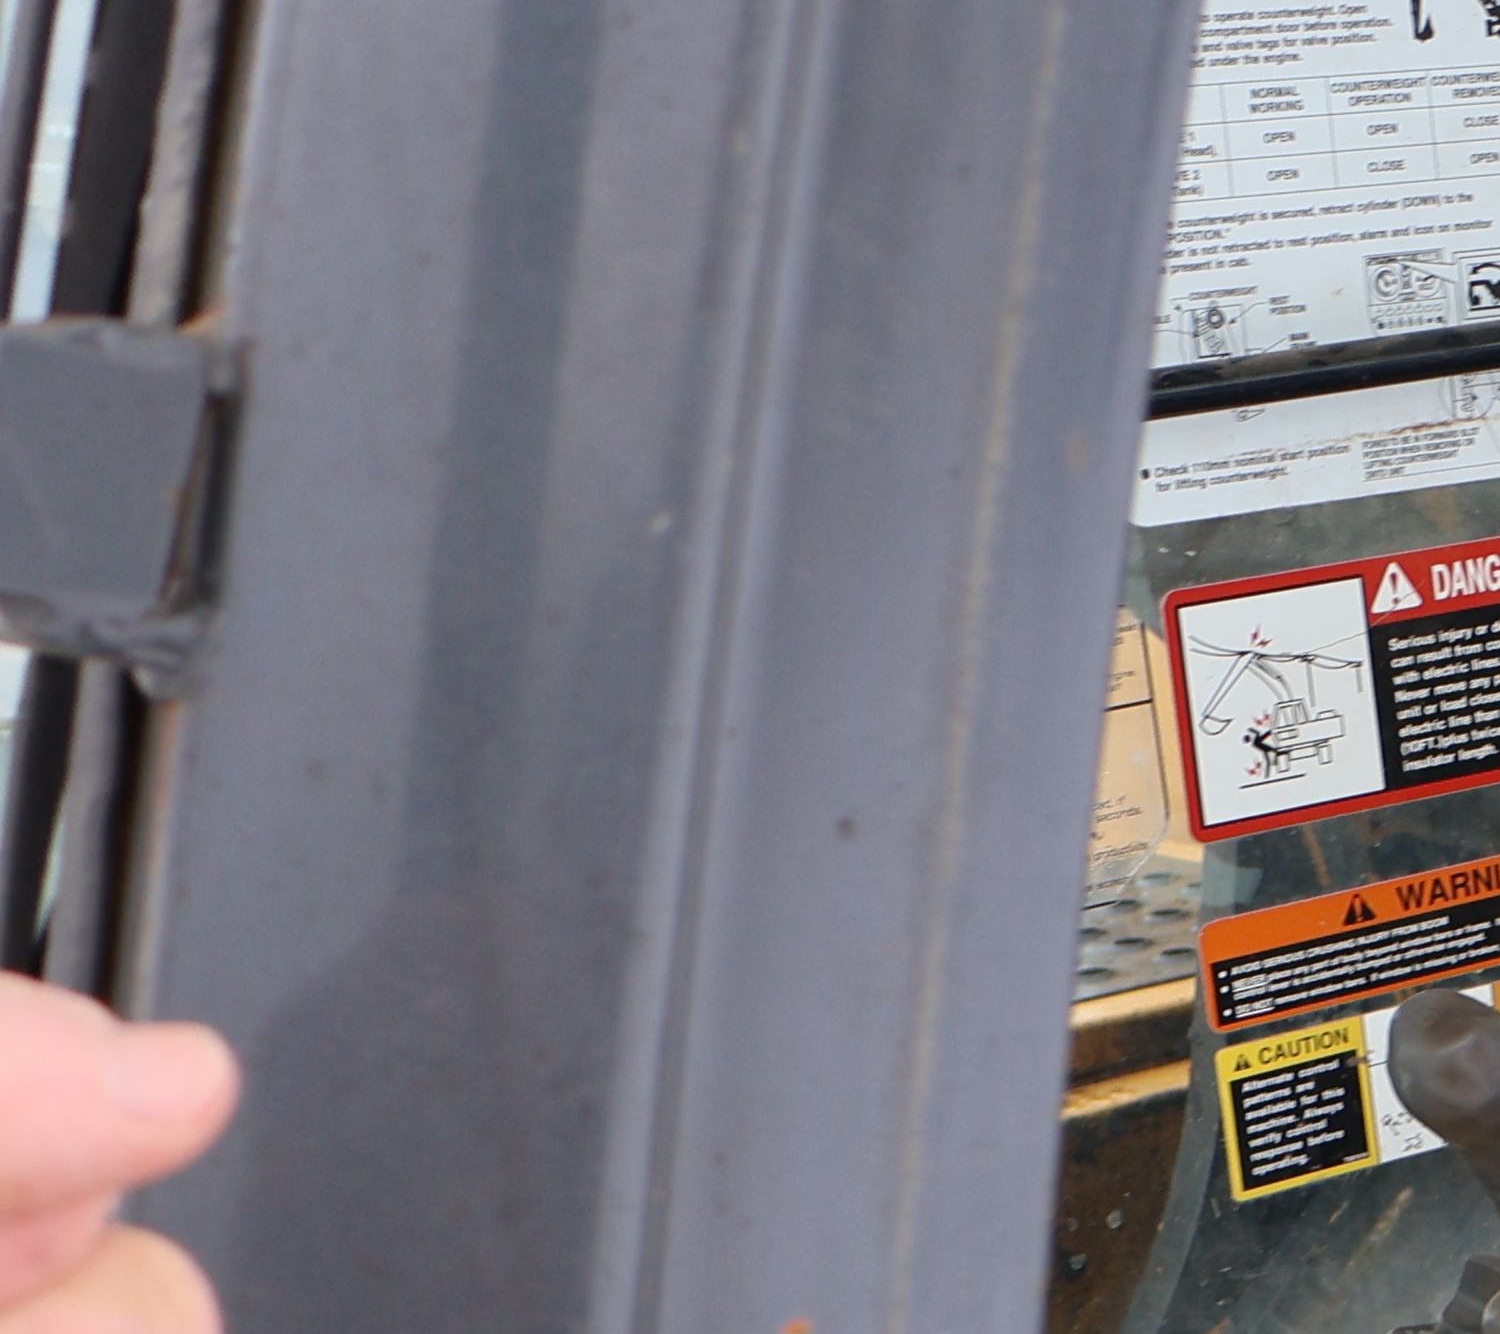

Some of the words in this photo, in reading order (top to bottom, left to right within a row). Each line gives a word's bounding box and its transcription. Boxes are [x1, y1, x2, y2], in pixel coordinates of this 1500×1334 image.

[1250, 86, 1299, 98] NORMAL
[1331, 76, 1426, 93] COUNTERWEIGHT
[1249, 100, 1303, 113] WORKING
[1349, 92, 1411, 106] OPERATION
[1367, 123, 1398, 135] OPEN
[1462, 114, 1500, 128] CLOSE
[1263, 131, 1295, 143] OPEN
[1367, 159, 1405, 173] CLOSE
[1469, 151, 1500, 164] OPEN
[1267, 168, 1299, 181] OPEN
[1154, 463, 1189, 478] Check
[1192, 460, 1231, 472] 110mm
[1232, 450, 1278, 467] nominal
[1277, 448, 1305, 462] start
[1306, 443, 1351, 459] position
[1154, 481, 1172, 493] for
[1173, 477, 1208, 490] lifting
[1209, 466, 1289, 485] counterweight.
[1387, 633, 1437, 651] Serious
[1437, 627, 1473, 642] injury
[1474, 624, 1488, 636] or
[1389, 655, 1415, 668] can
[1416, 646, 1453, 663] result
[1453, 643, 1483, 657] from
[1392, 670, 1420, 685] with
[1422, 662, 1469, 680] electric
[1393, 687, 1430, 703] Never
[1433, 680, 1467, 695] move
[1468, 676, 1491, 689] any
[1396, 704, 1422, 720] unit
[1423, 703, 1437, 715] or
[1439, 695, 1468, 712] load
[1398, 719, 1446, 737] electric
[1447, 714, 1472, 728] line
[1473, 709, 1500, 723] than
[1400, 732, 1469, 755] (10FT.)plus
[1402, 753, 1455, 772] insulator
[1457, 744, 1499, 761] length.
[1258, 1027, 1349, 1065] CAUTION
